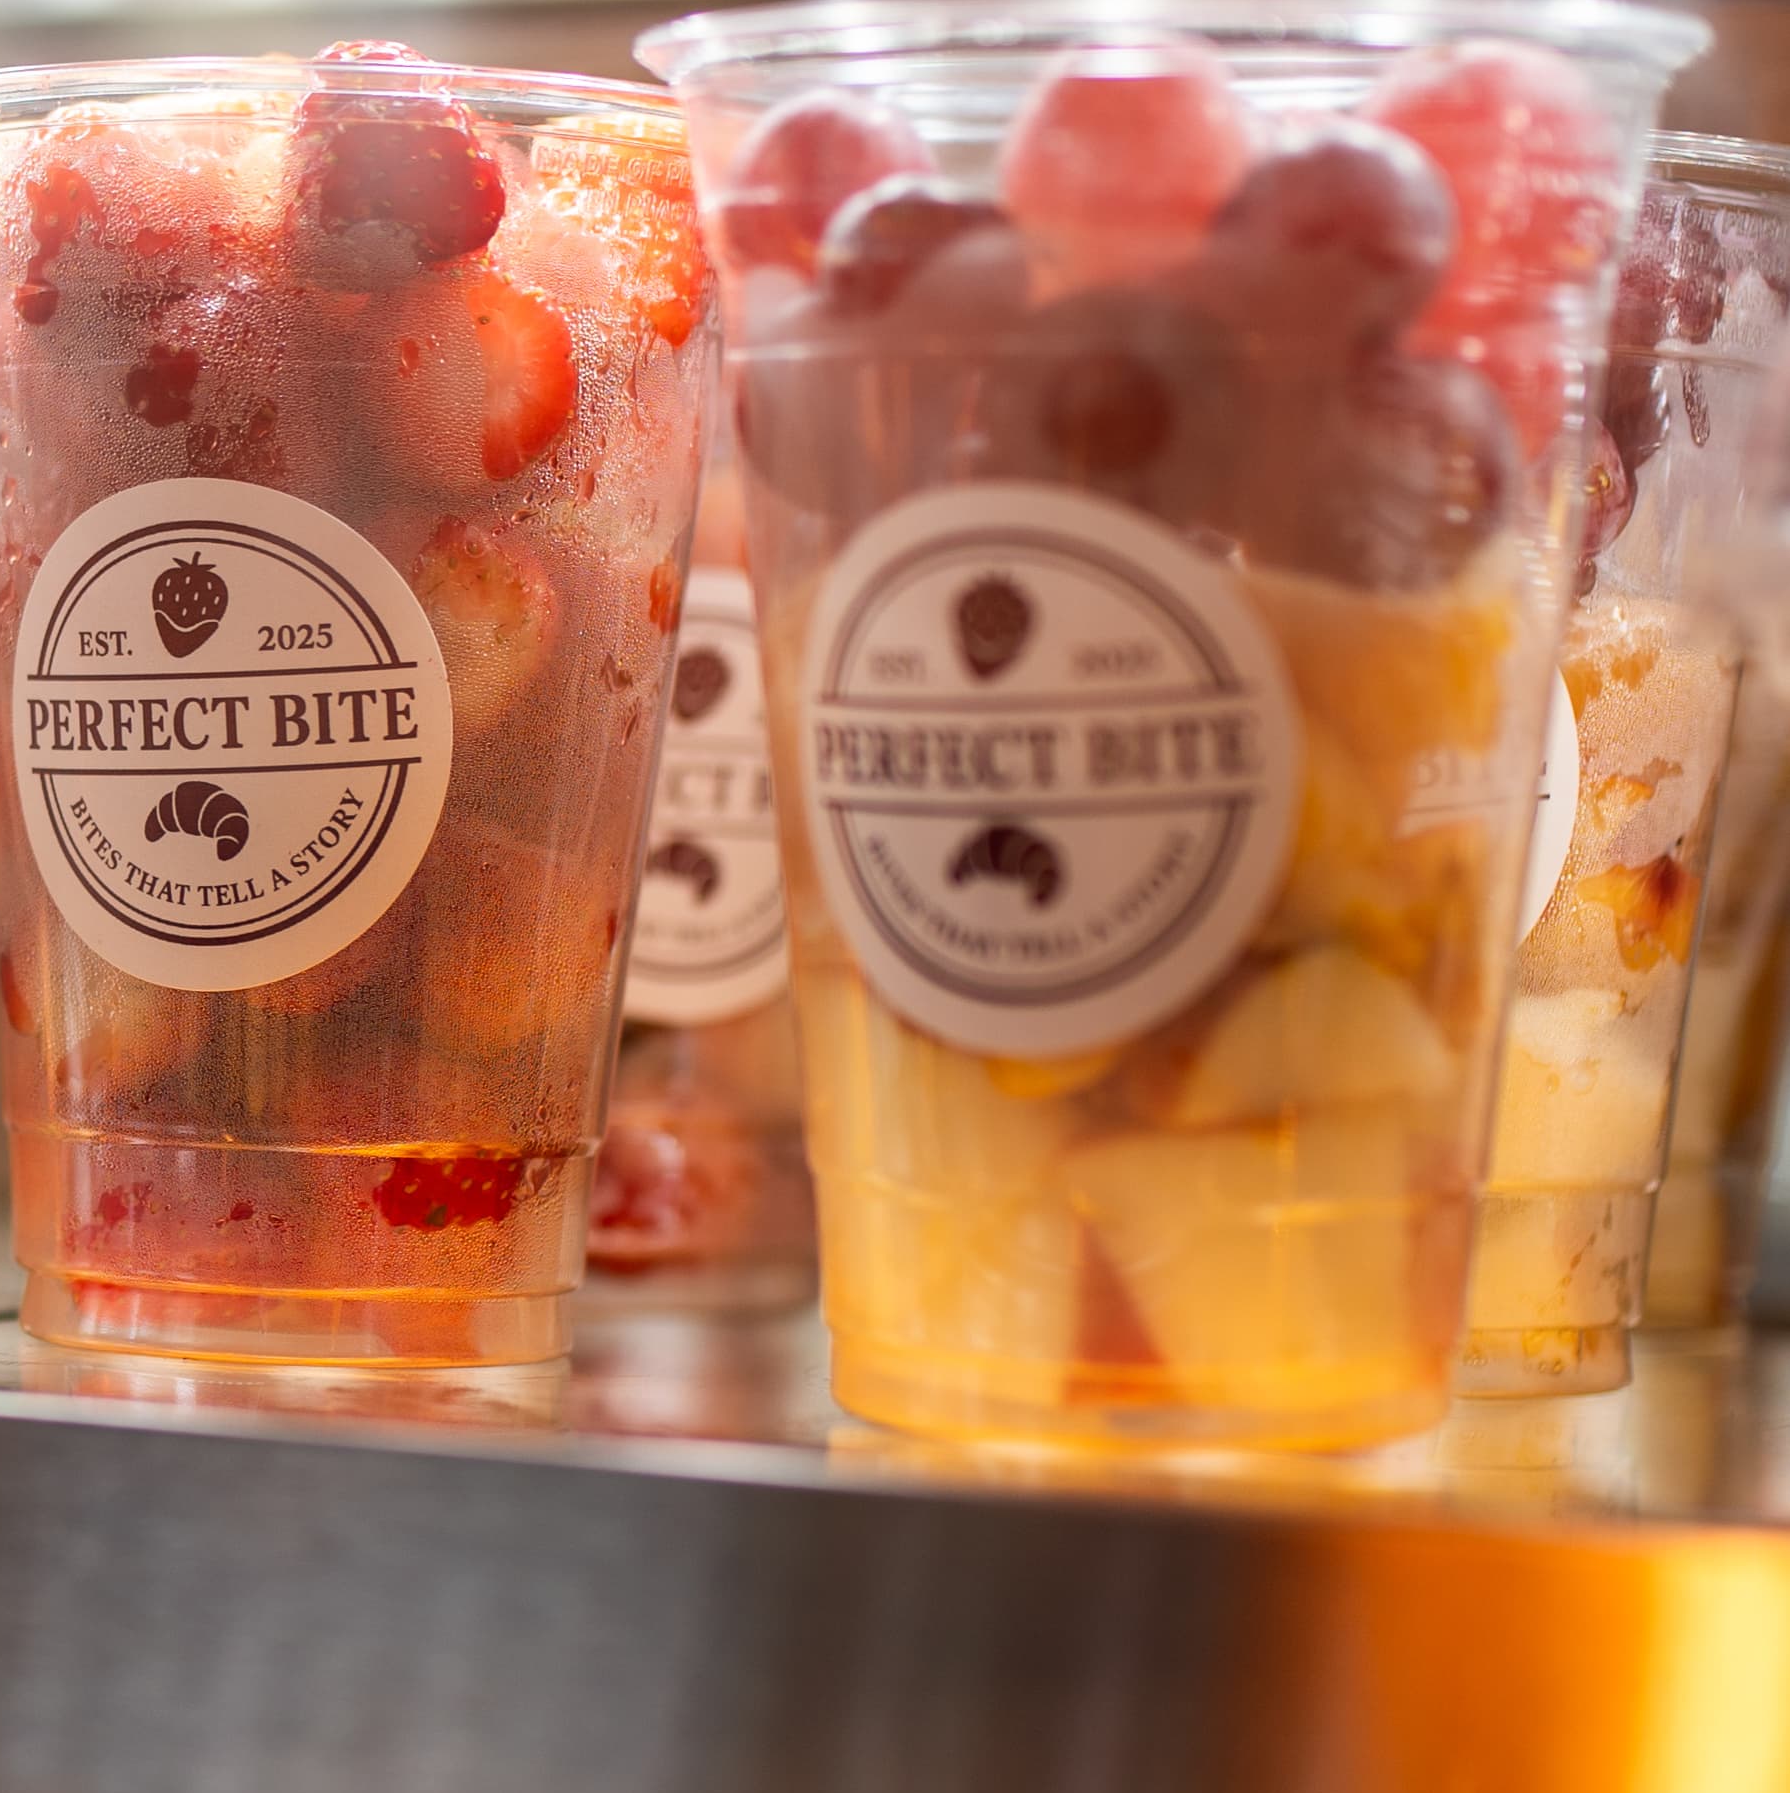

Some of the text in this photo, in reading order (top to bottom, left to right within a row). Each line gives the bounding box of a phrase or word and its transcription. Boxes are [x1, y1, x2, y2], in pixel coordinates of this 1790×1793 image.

[78, 623, 334, 657] EST. 2025
[27, 687, 419, 752] PERFECT BITE
[817, 722, 1058, 791] PERFECT
[70, 787, 364, 907] BITES THAT TELL A STORY
